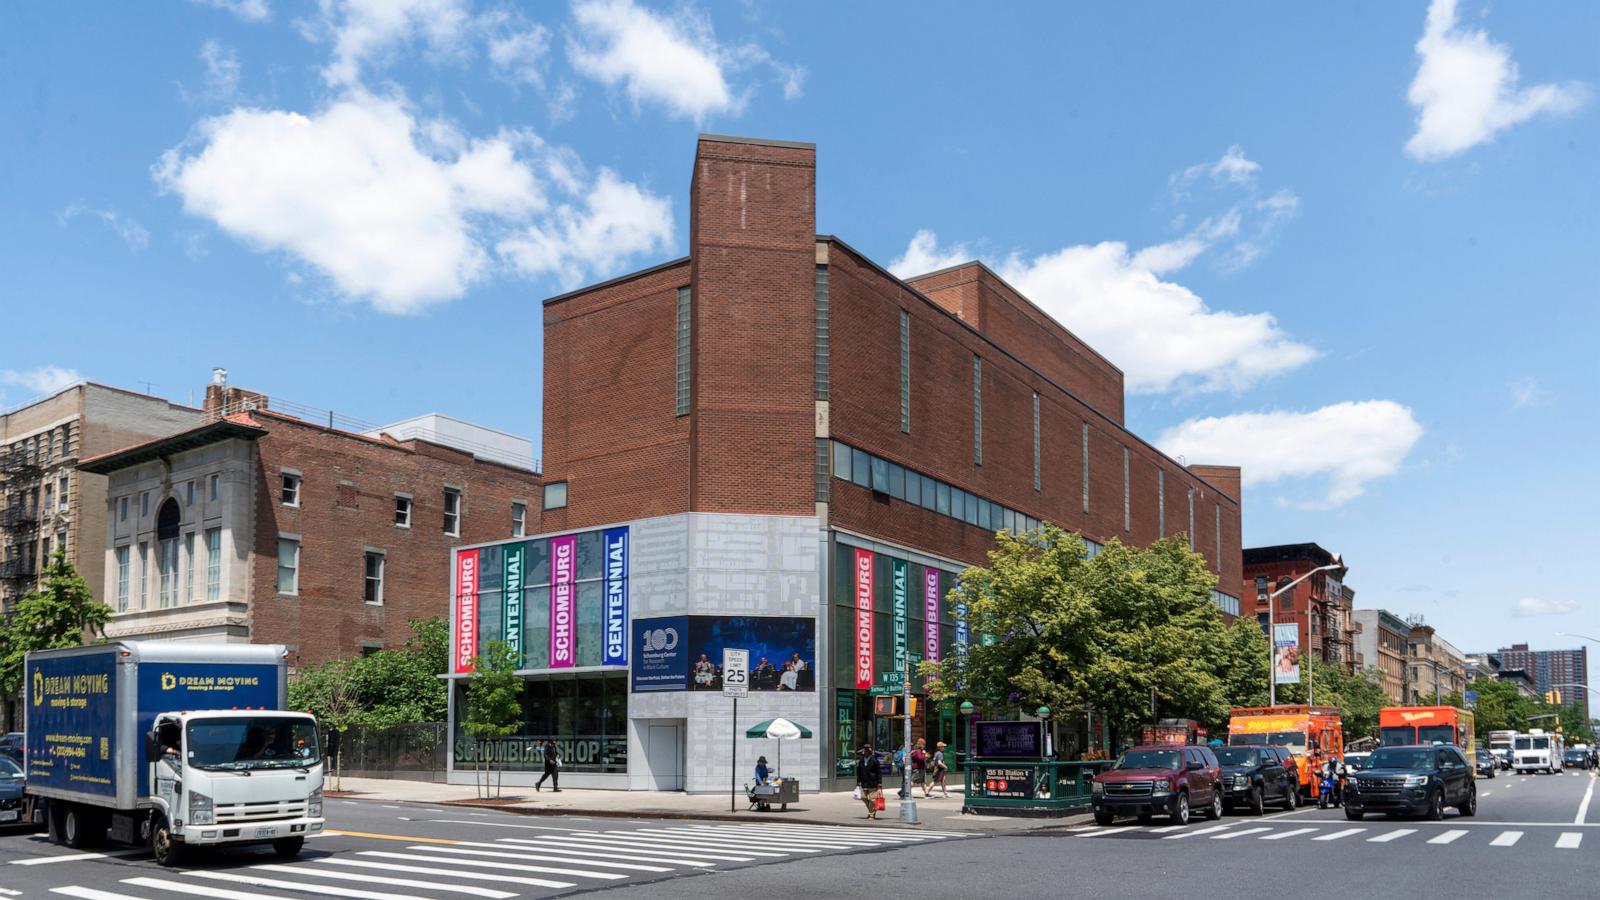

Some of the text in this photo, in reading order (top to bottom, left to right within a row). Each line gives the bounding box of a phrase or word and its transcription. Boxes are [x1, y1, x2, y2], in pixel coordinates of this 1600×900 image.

[461, 557, 474, 666] SCHOMBURG
[556, 544, 570, 661] SCHOMBURG
[608, 536, 624, 658] CENTENNIAL
[860, 557, 871, 682] SCHOMBURG
[896, 566, 905, 671] ENTENNIAL
[643, 628, 678, 652] 100
[45, 674, 108, 695] DREAM MOVING
[179, 677, 258, 685] DREAM MOVING
[728, 669, 745, 682] 25
[555, 740, 599, 763] SHOP
